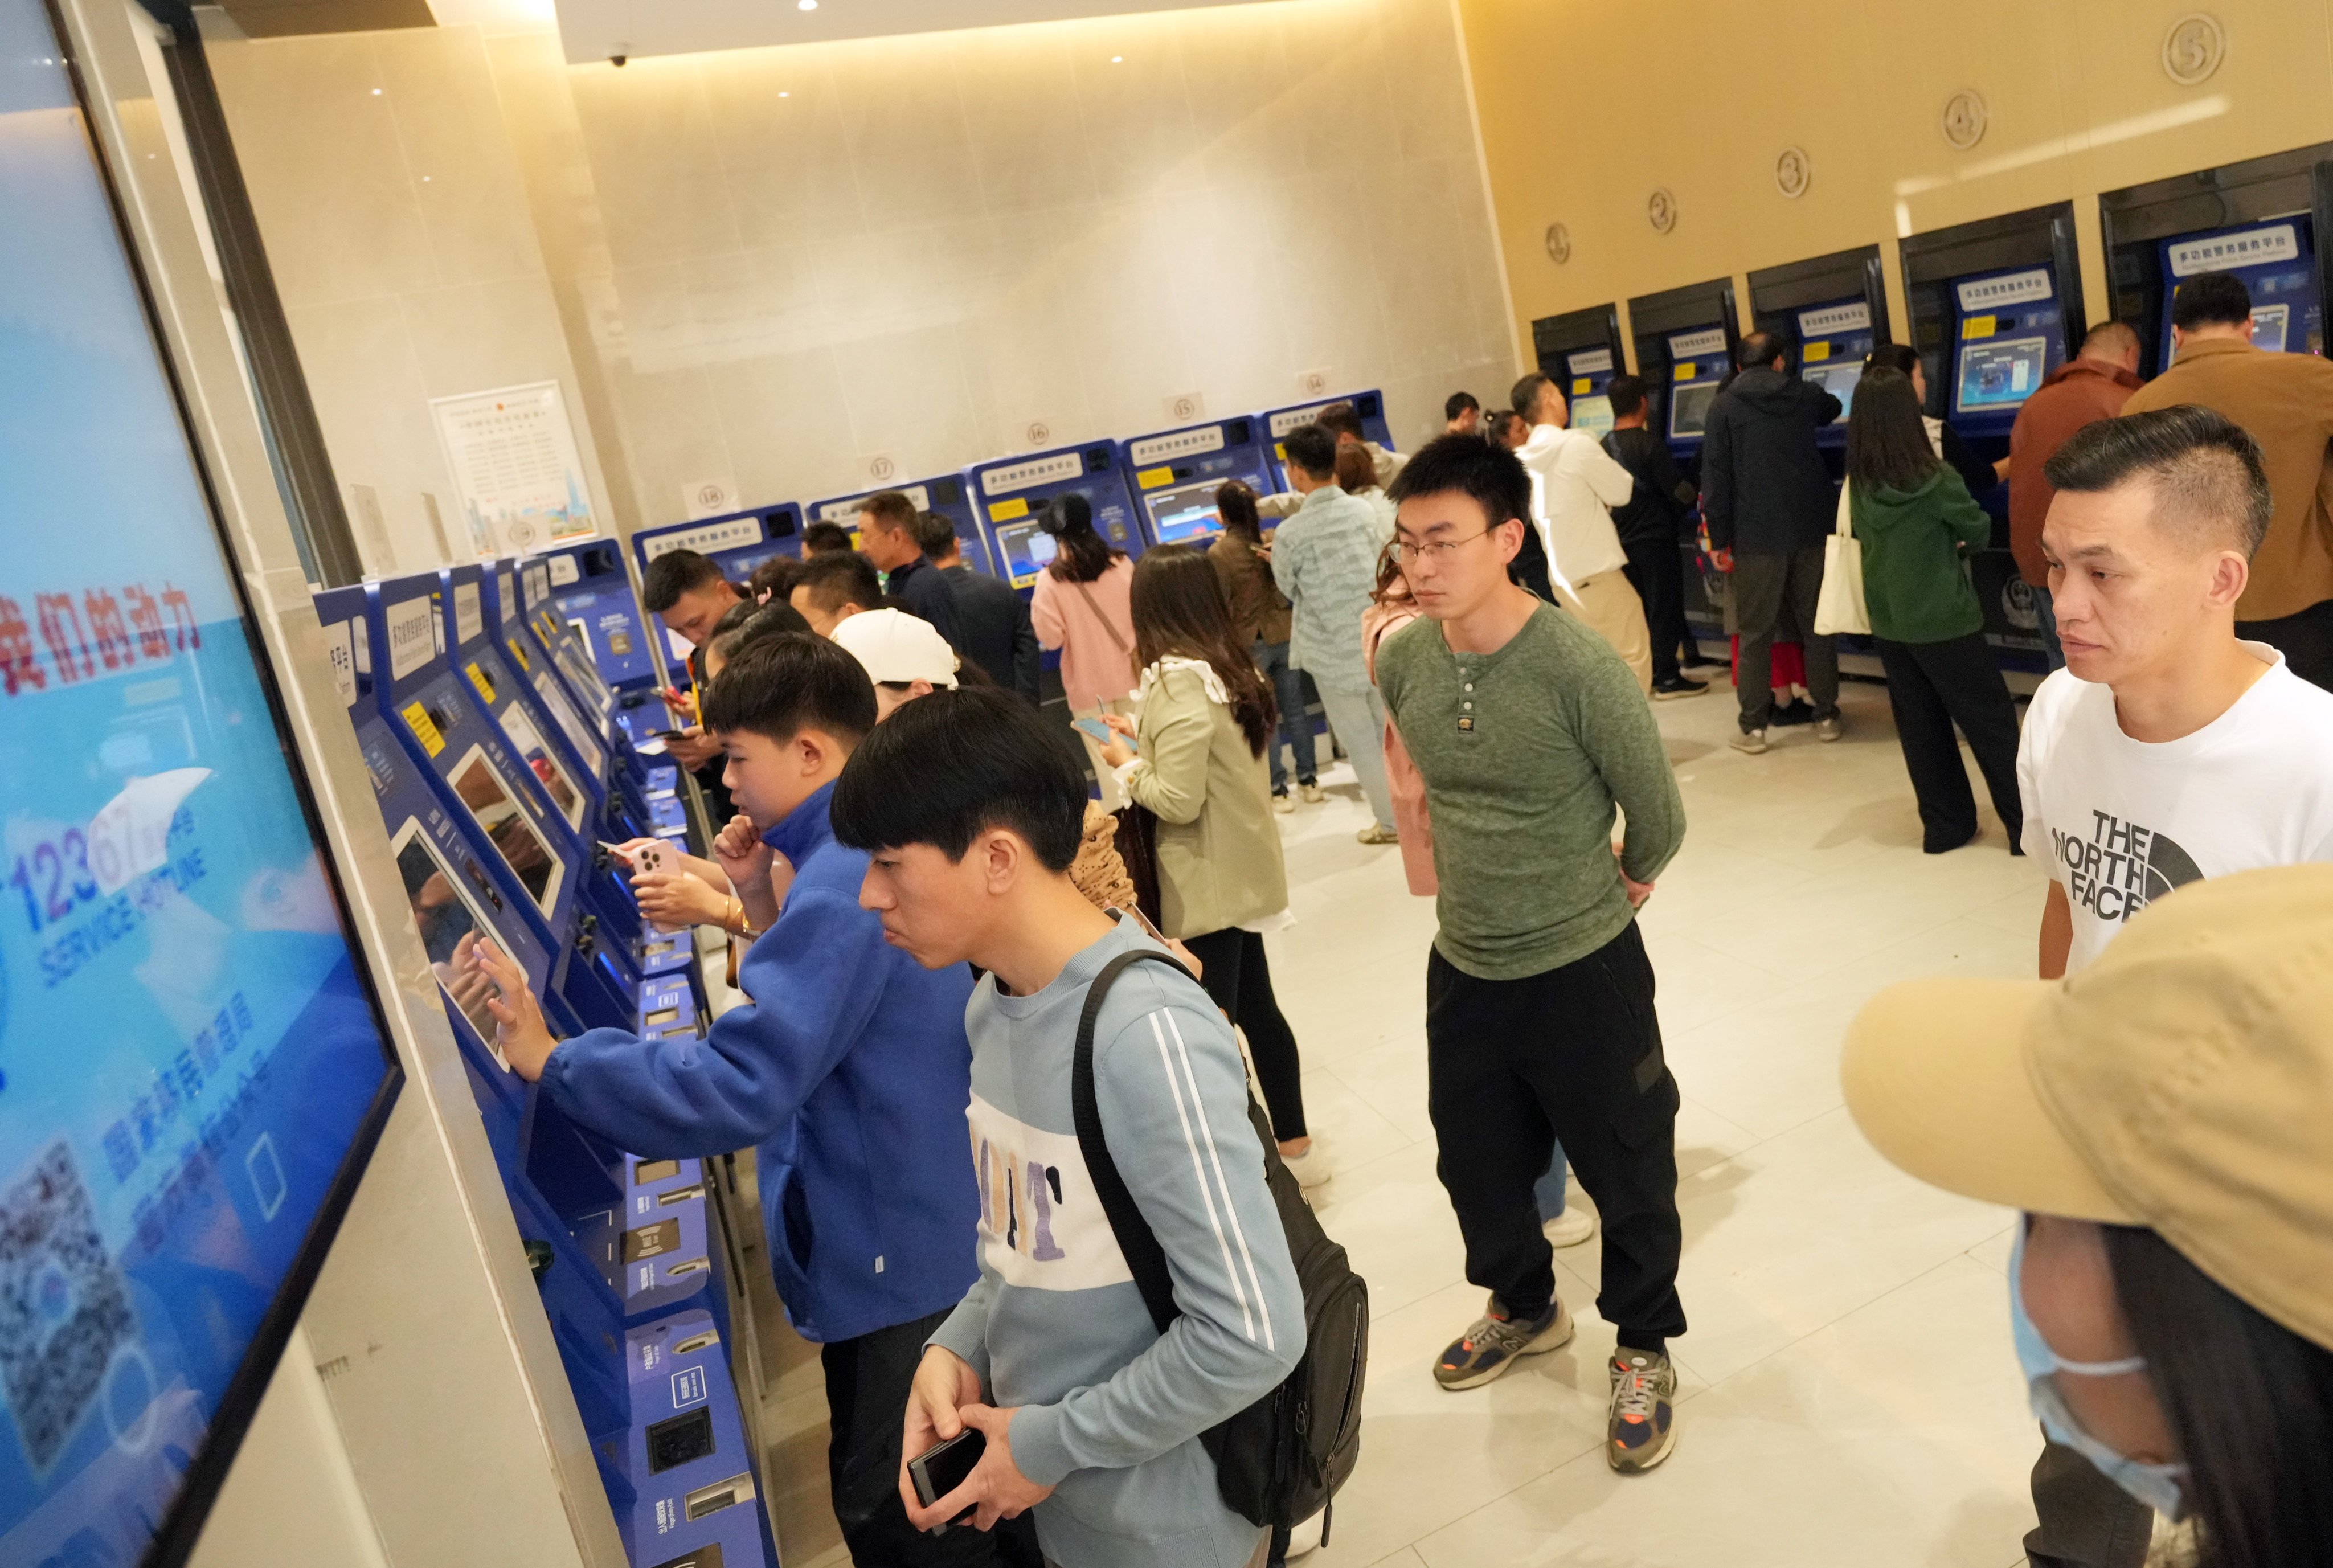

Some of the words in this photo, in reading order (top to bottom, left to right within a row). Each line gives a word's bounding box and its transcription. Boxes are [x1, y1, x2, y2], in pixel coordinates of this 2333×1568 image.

[2179, 236, 2285, 262] 多功能警务服务平台
[2052, 827, 2144, 896] NORTH
[2093, 809, 2150, 863] THE
[38, 892, 136, 991] SERVICE
